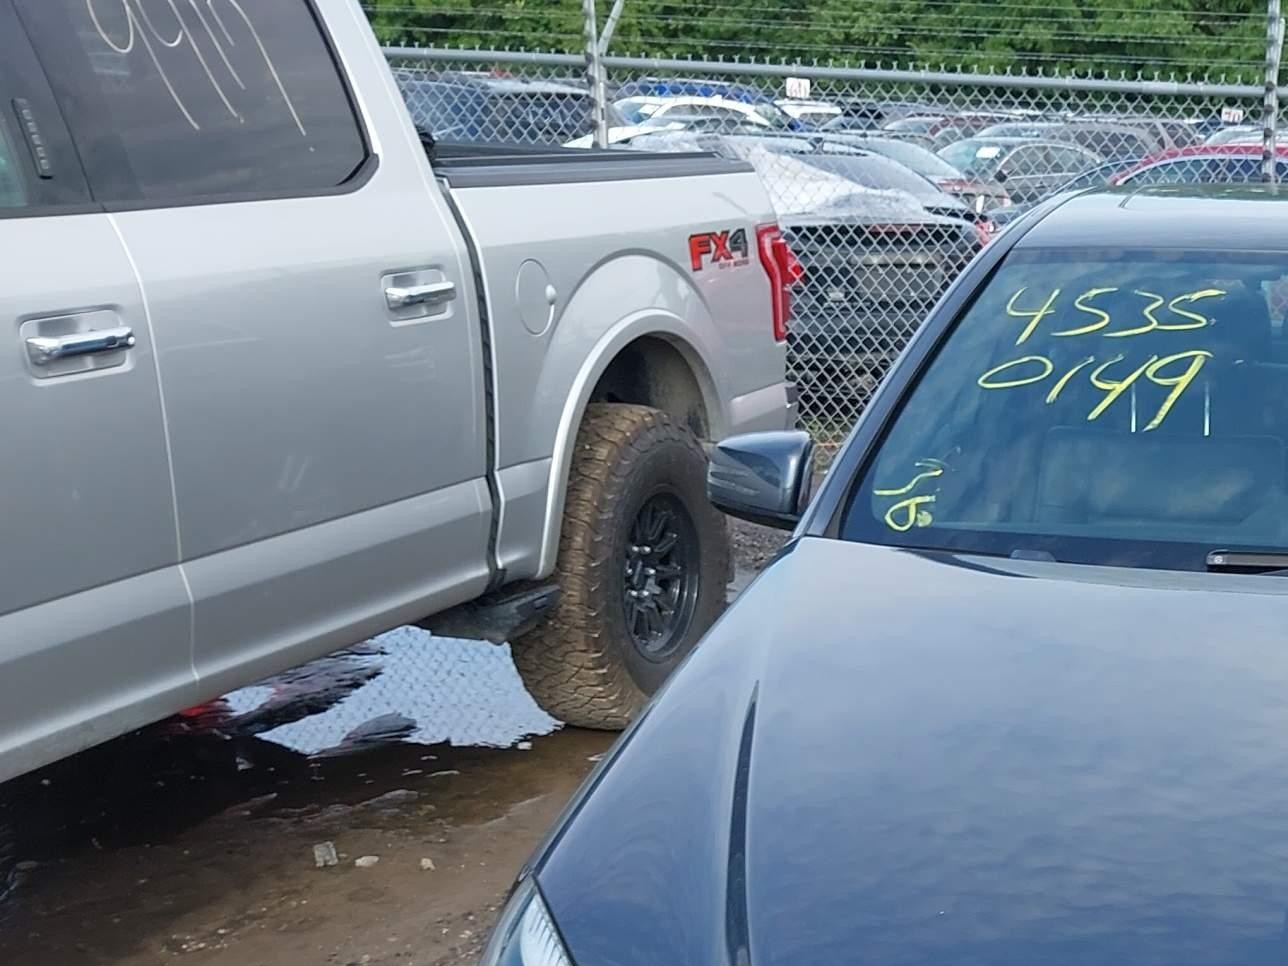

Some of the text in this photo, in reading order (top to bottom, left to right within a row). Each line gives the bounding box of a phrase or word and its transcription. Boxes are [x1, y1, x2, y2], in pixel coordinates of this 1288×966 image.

[688, 228, 749, 272] FX4
[1005, 286, 1227, 346] 4535
[977, 350, 1214, 432] 0149
